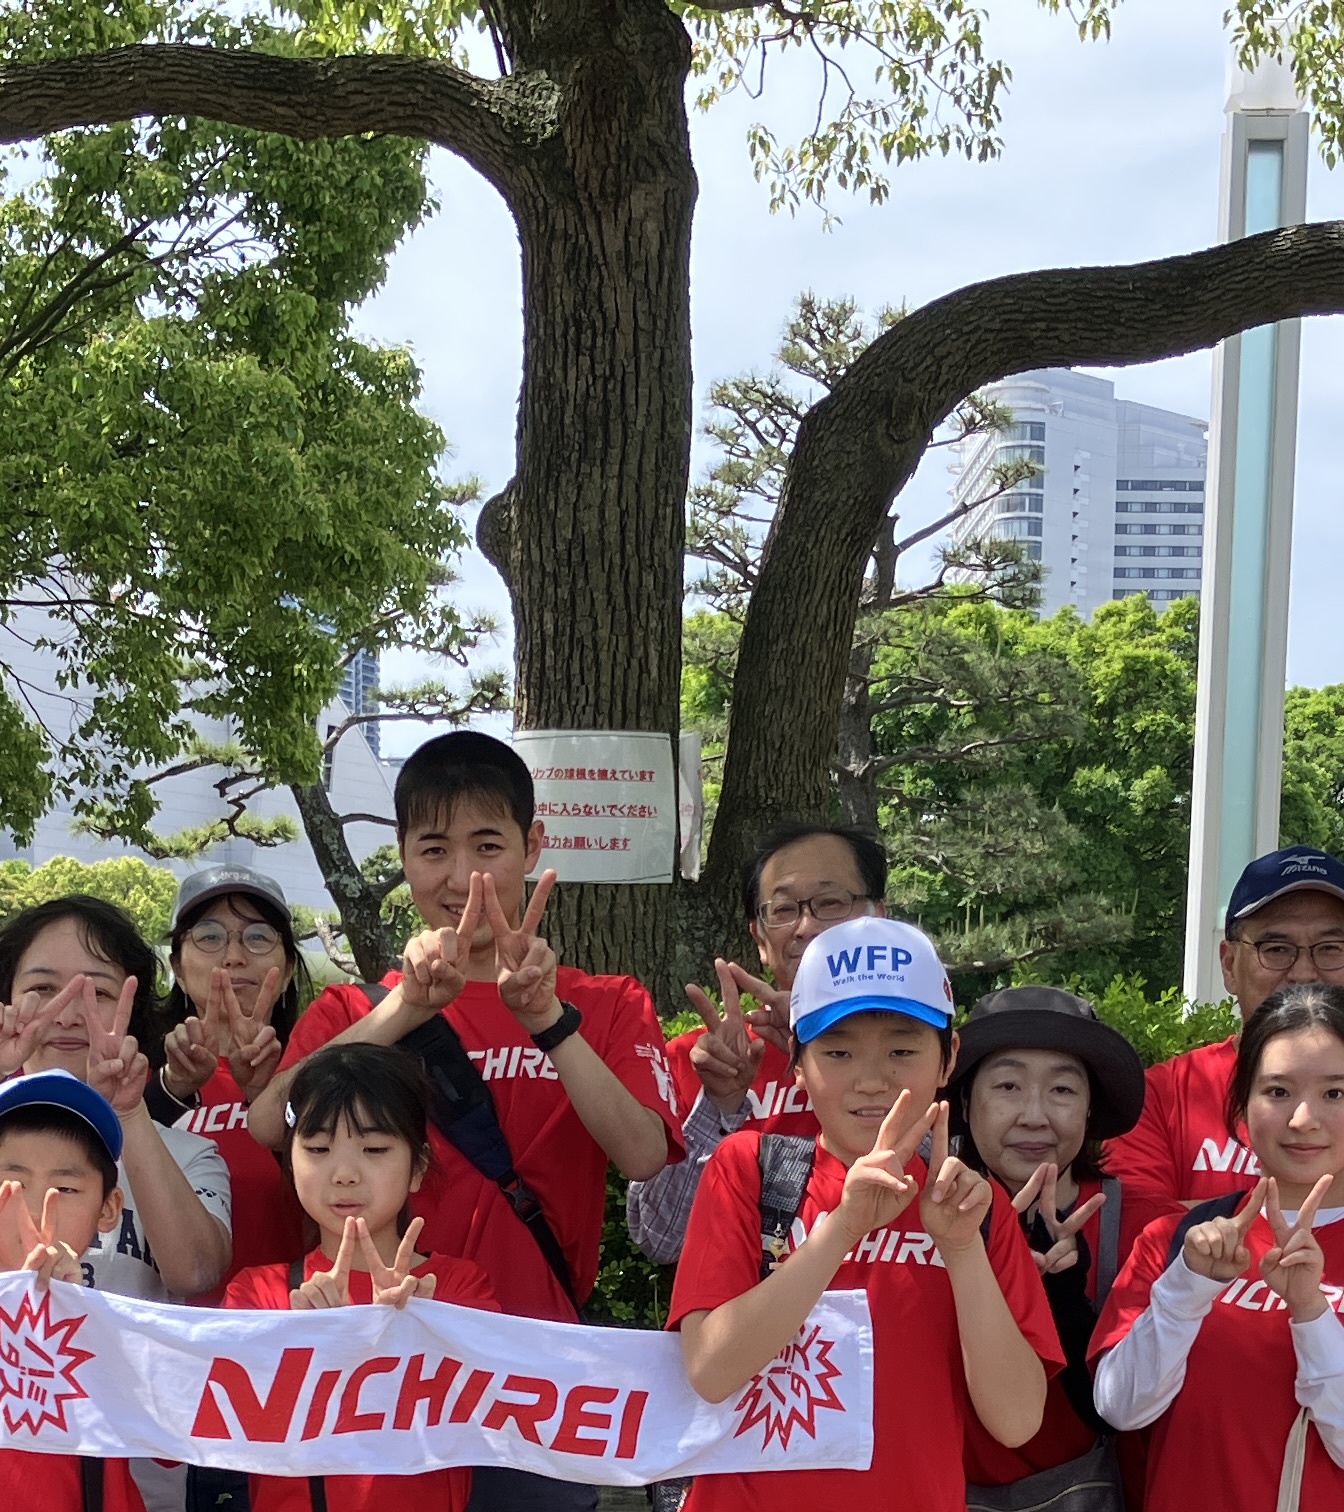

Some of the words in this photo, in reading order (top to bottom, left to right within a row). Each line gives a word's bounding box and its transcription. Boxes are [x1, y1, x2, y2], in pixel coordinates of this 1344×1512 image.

[531, 768, 656, 782] リップの球根を植えています
[826, 945, 913, 979] WFP
[833, 974, 855, 987] Walk
[858, 973, 874, 982] the
[877, 973, 905, 983] World
[192, 1347, 649, 1459] NICHIREI
